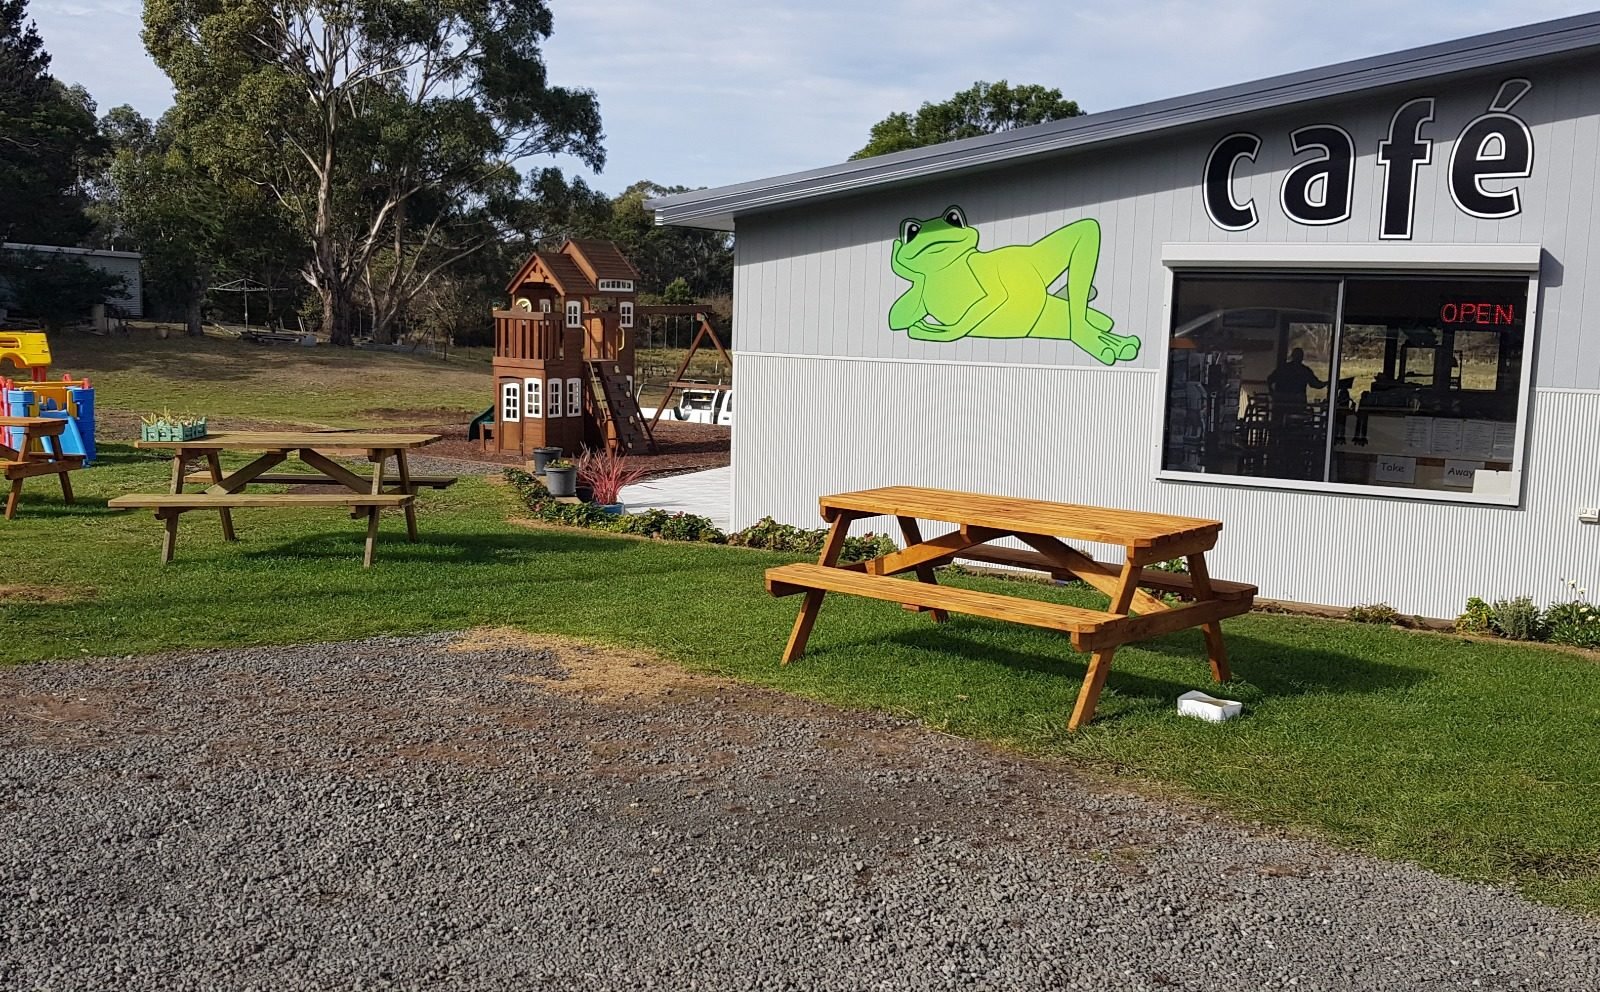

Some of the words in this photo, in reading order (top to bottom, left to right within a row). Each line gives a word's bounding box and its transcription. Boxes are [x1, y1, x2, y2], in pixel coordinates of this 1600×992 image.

[1202, 78, 1535, 240] café
[1442, 303, 1513, 325] OPEN
[1381, 462, 1405, 473] Take
[1447, 467, 1475, 479] Away
